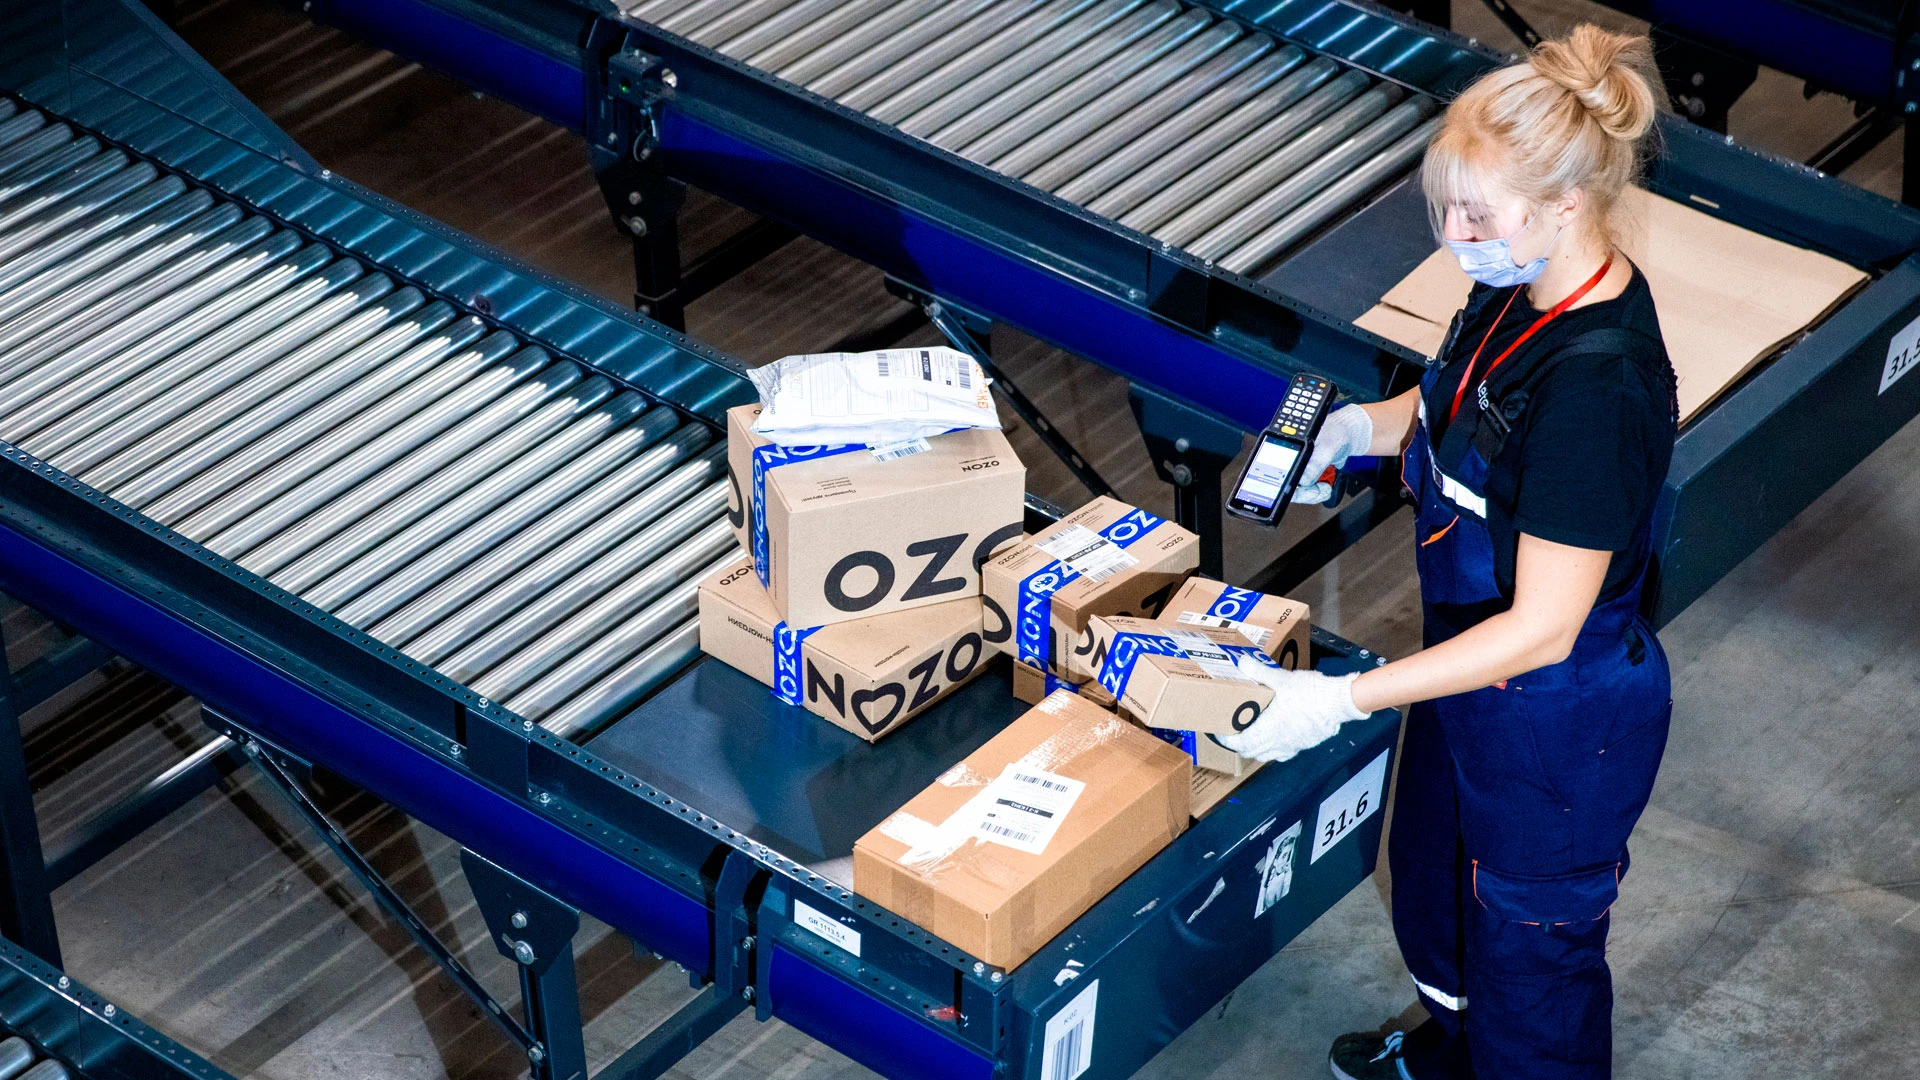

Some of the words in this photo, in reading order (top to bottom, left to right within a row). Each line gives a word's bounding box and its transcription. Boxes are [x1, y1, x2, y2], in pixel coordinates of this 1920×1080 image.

[961, 459, 1000, 473] OZON
[1161, 535, 1184, 551] OZON
[1276, 607, 1293, 625] OZON
[1322, 790, 1369, 847] 31.6
[808, 916, 819, 926] GR
